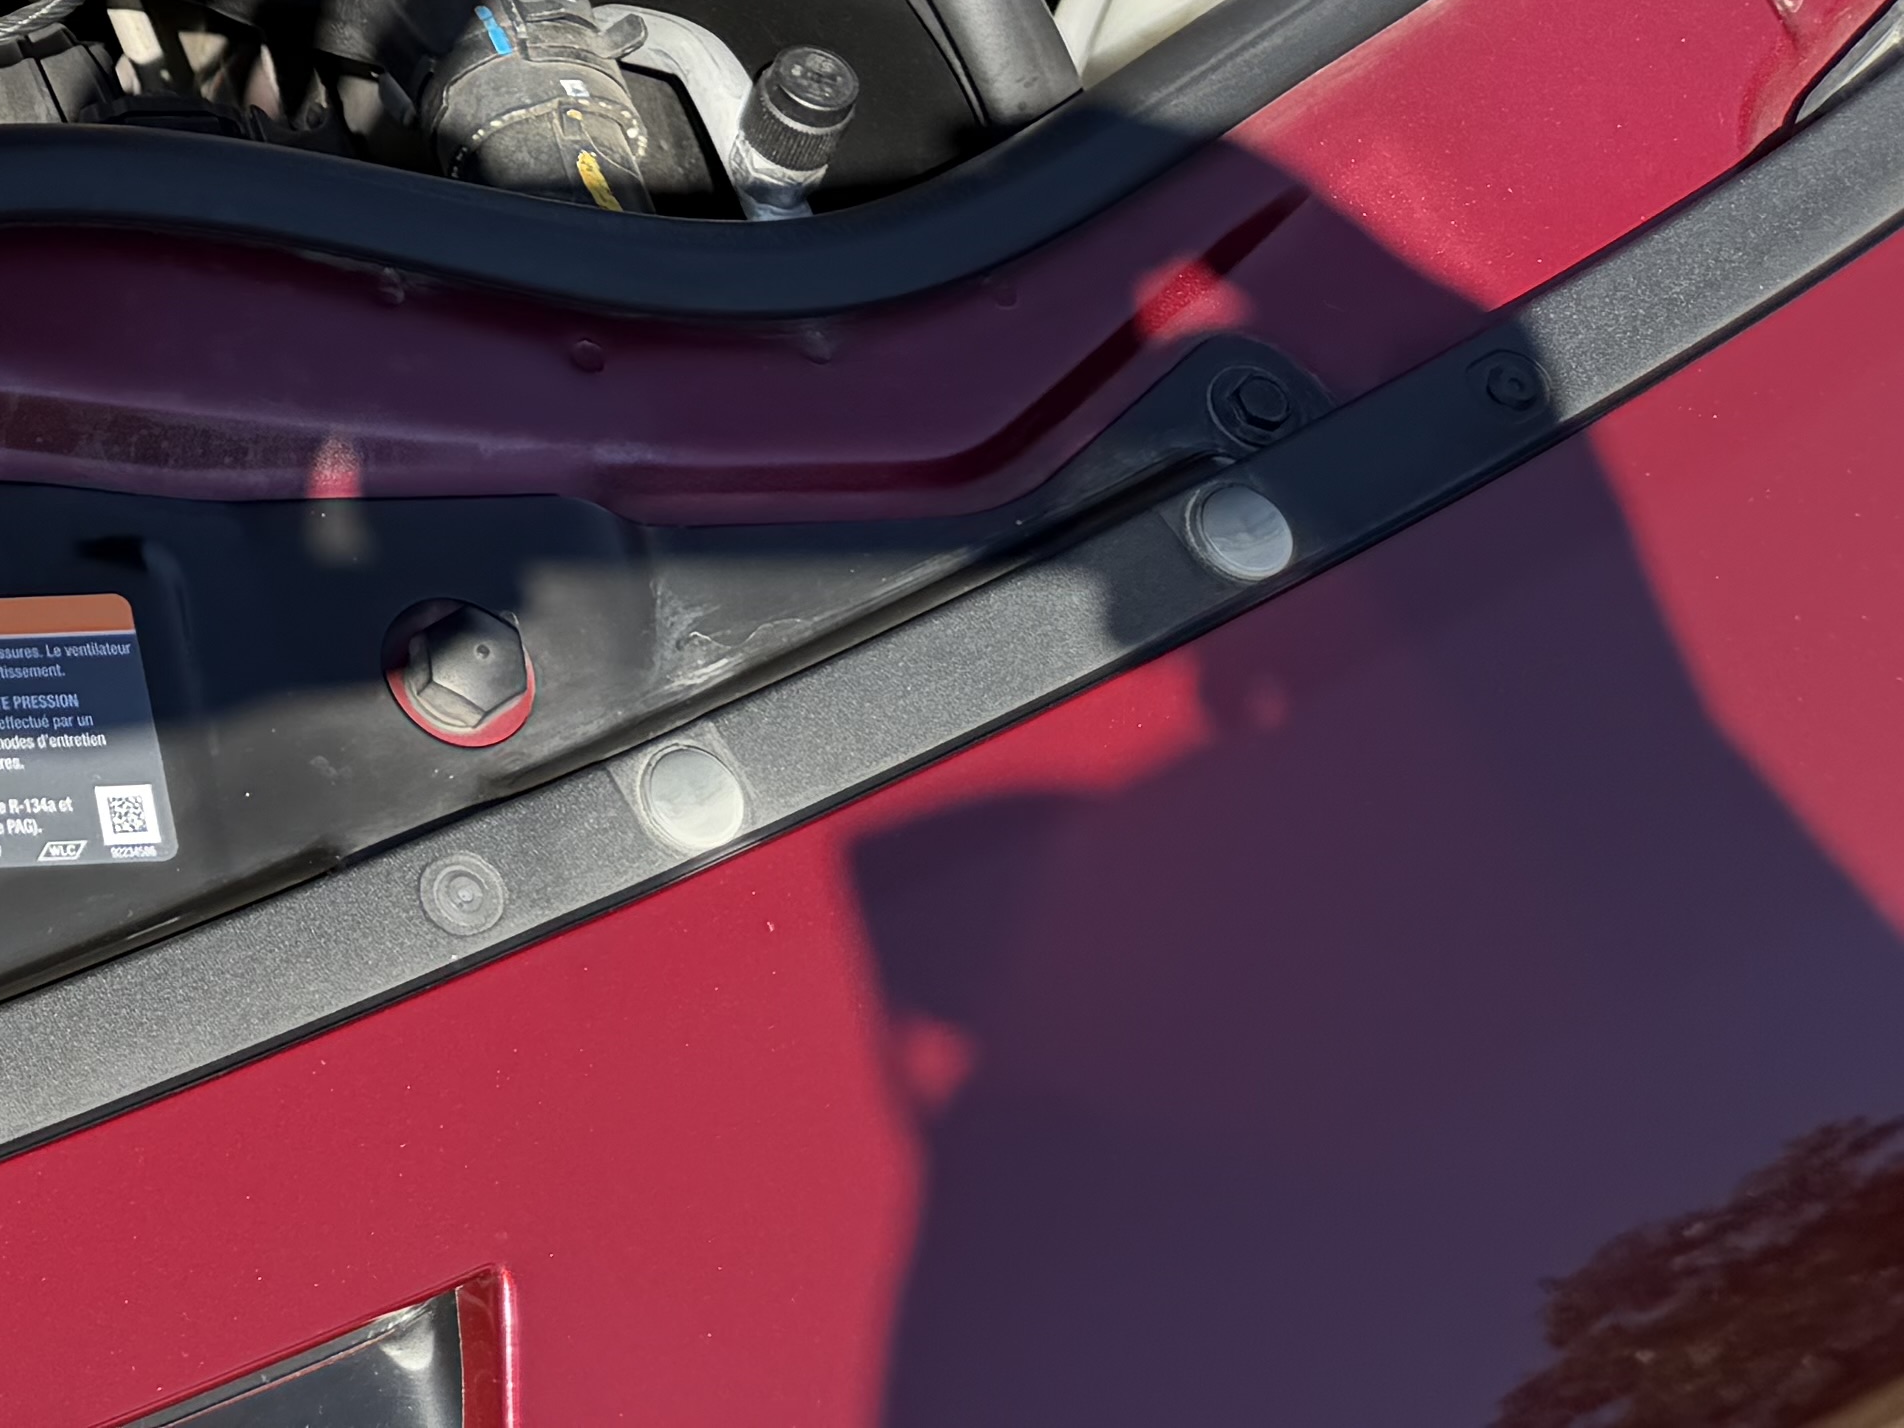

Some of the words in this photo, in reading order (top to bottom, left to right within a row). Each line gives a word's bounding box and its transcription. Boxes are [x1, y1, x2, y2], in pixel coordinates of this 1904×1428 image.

[45, 644, 61, 657] Le
[64, 642, 130, 656] ventilateur
[13, 694, 79, 709] PRESSION
[52, 716, 73, 730] par
[77, 715, 93, 726] un
[37, 732, 106, 749] d'entretien
[59, 797, 73, 812] et
